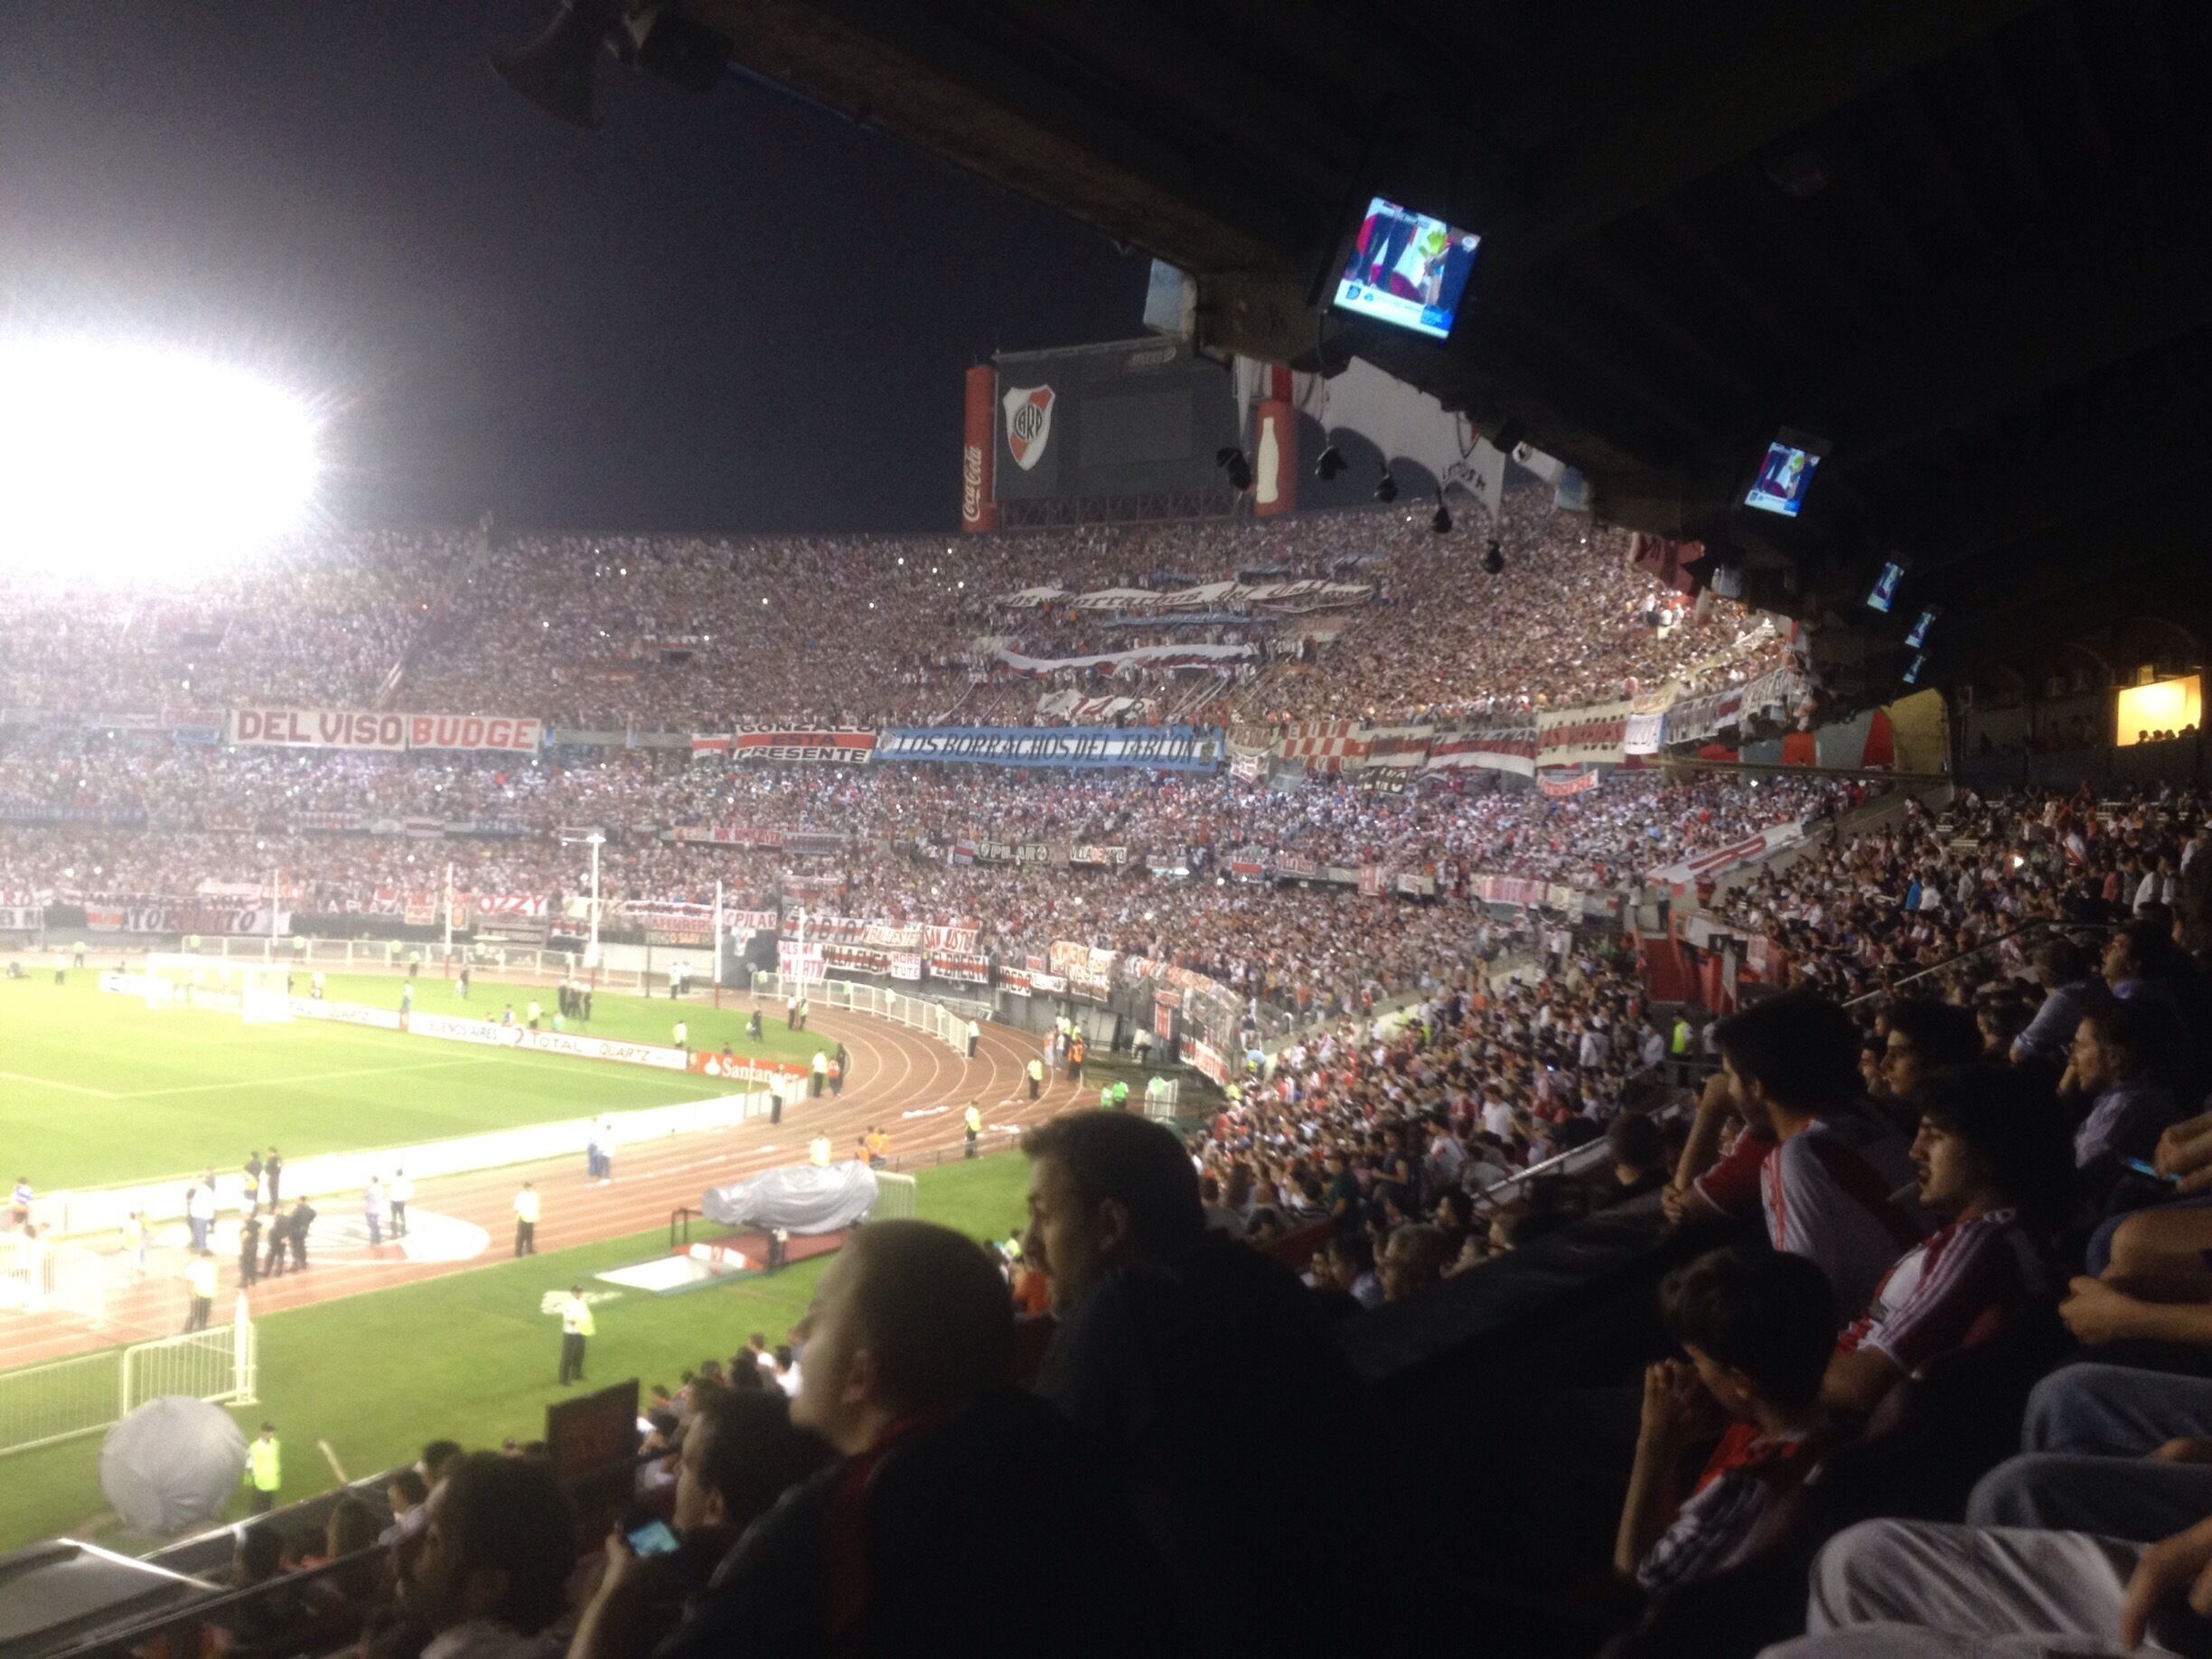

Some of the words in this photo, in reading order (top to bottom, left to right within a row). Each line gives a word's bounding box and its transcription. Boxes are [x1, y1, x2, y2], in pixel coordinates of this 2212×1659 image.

[238, 710, 311, 741] DEL
[320, 712, 403, 745] VISO
[412, 717, 537, 749] BUDGE
[736, 746, 867, 763] PRESENTE
[896, 733, 942, 756] LOS
[942, 733, 1073, 761] BORRACHOS
[1071, 735, 1111, 762] DEL
[1119, 734, 1196, 764] TABLON
[477, 894, 546, 915] OZZY
[735, 912, 776, 929] PILAR
[470, 1025, 498, 1040] AIRES
[531, 1032, 582, 1053] TOTAL
[599, 1042, 651, 1062] QUARTZ
[721, 1056, 800, 1083] Santaner
